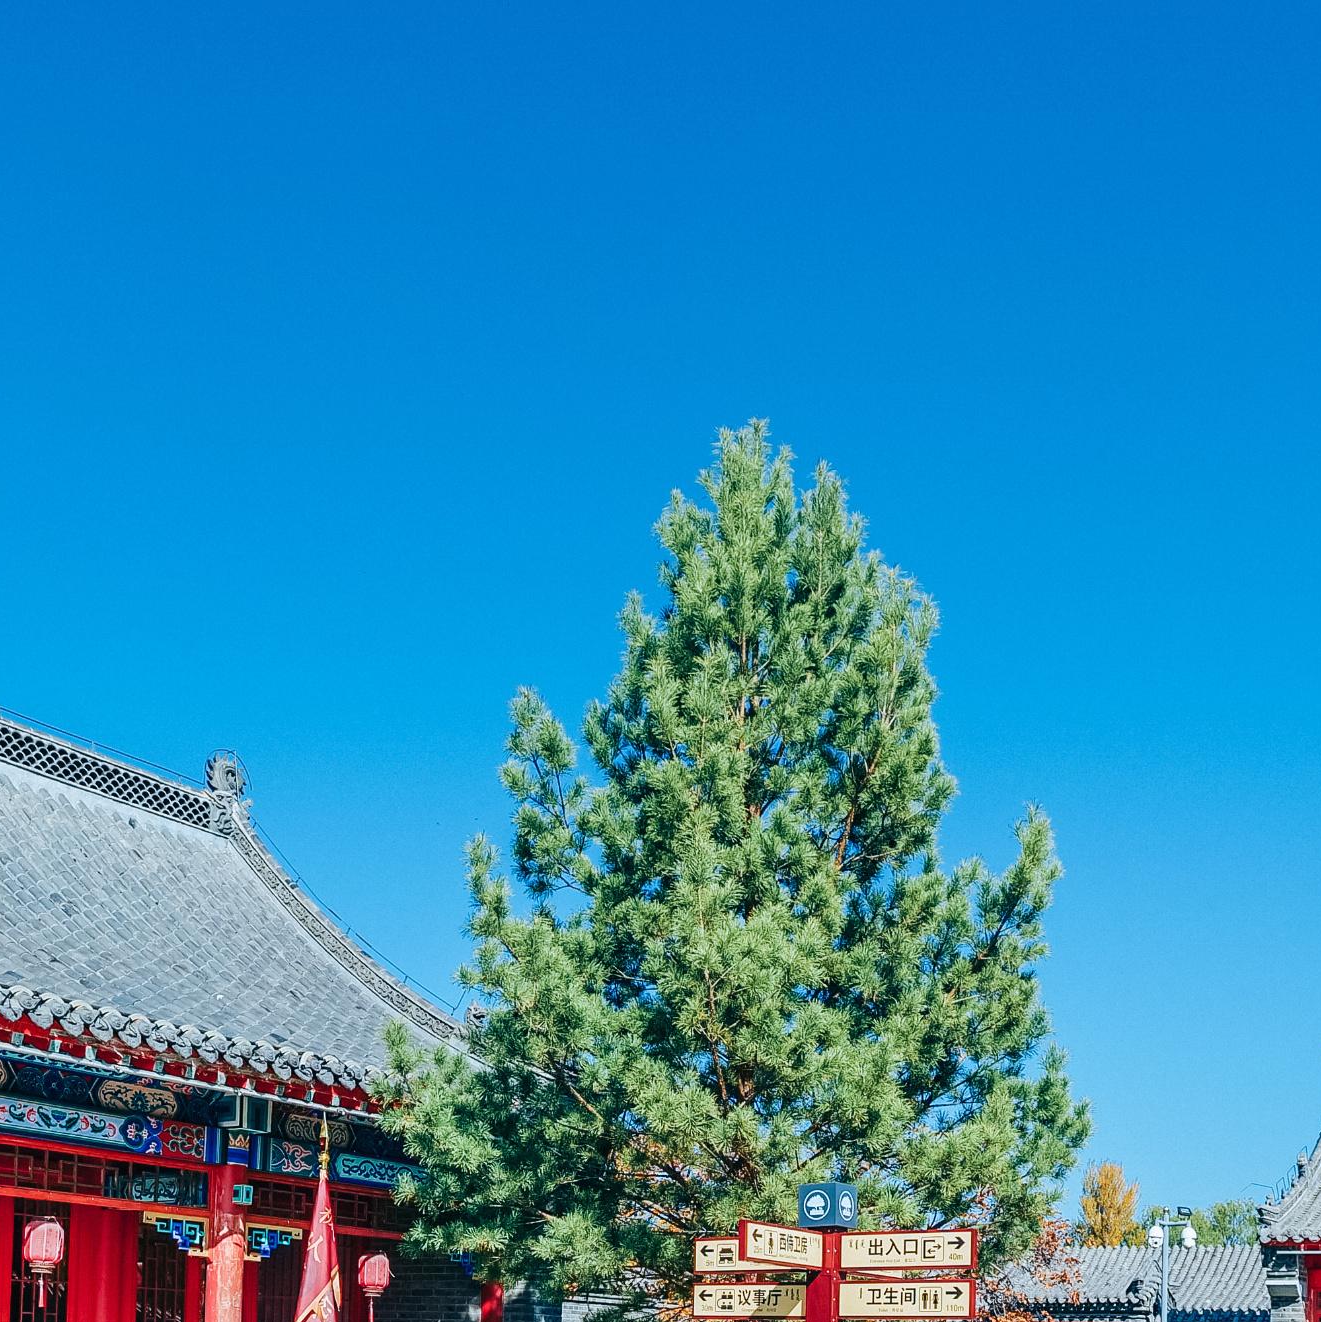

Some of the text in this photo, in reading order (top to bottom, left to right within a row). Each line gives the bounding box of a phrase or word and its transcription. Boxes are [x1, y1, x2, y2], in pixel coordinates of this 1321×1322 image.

[868, 1238, 918, 1256] 出入口
[948, 1253, 964, 1261] 40m
[737, 1289, 782, 1306] 议事厅
[866, 1287, 917, 1306] 卫生间
[946, 1304, 965, 1312] 110m
